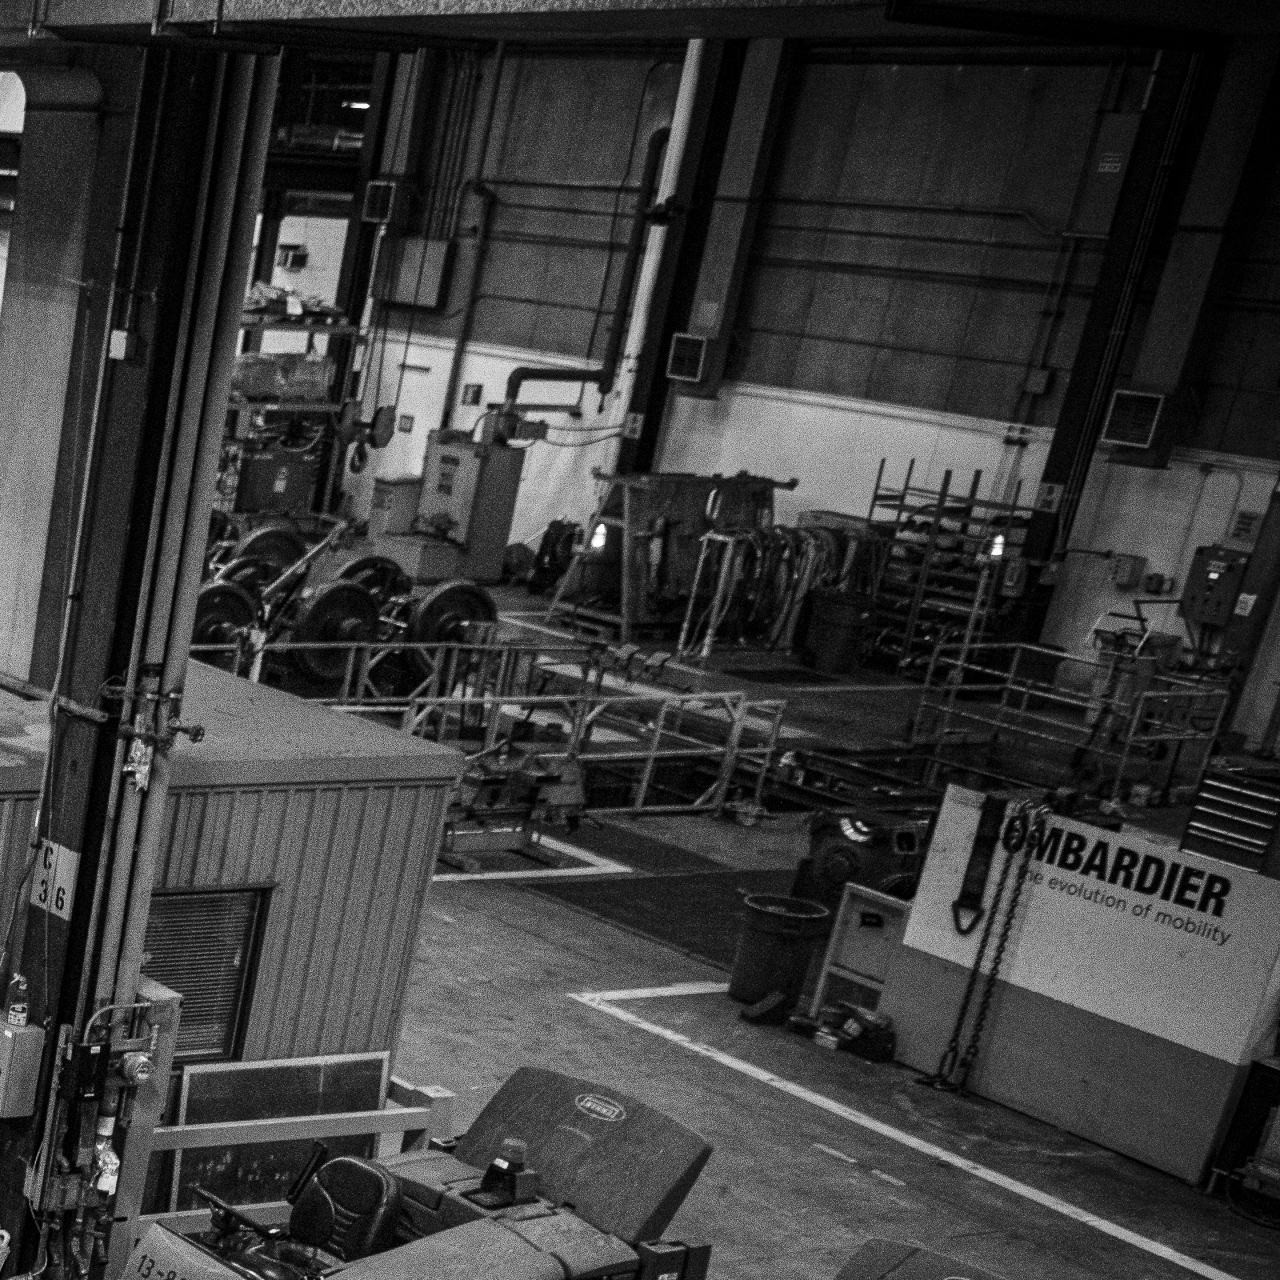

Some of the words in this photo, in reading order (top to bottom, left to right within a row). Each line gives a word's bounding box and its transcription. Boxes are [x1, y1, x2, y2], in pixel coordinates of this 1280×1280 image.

[42, 846, 55, 870] C
[1002, 815, 1232, 919] OMBARDIER
[1047, 876, 1128, 912] evolution
[1131, 902, 1154, 919] of
[1154, 911, 1232, 947] mobility
